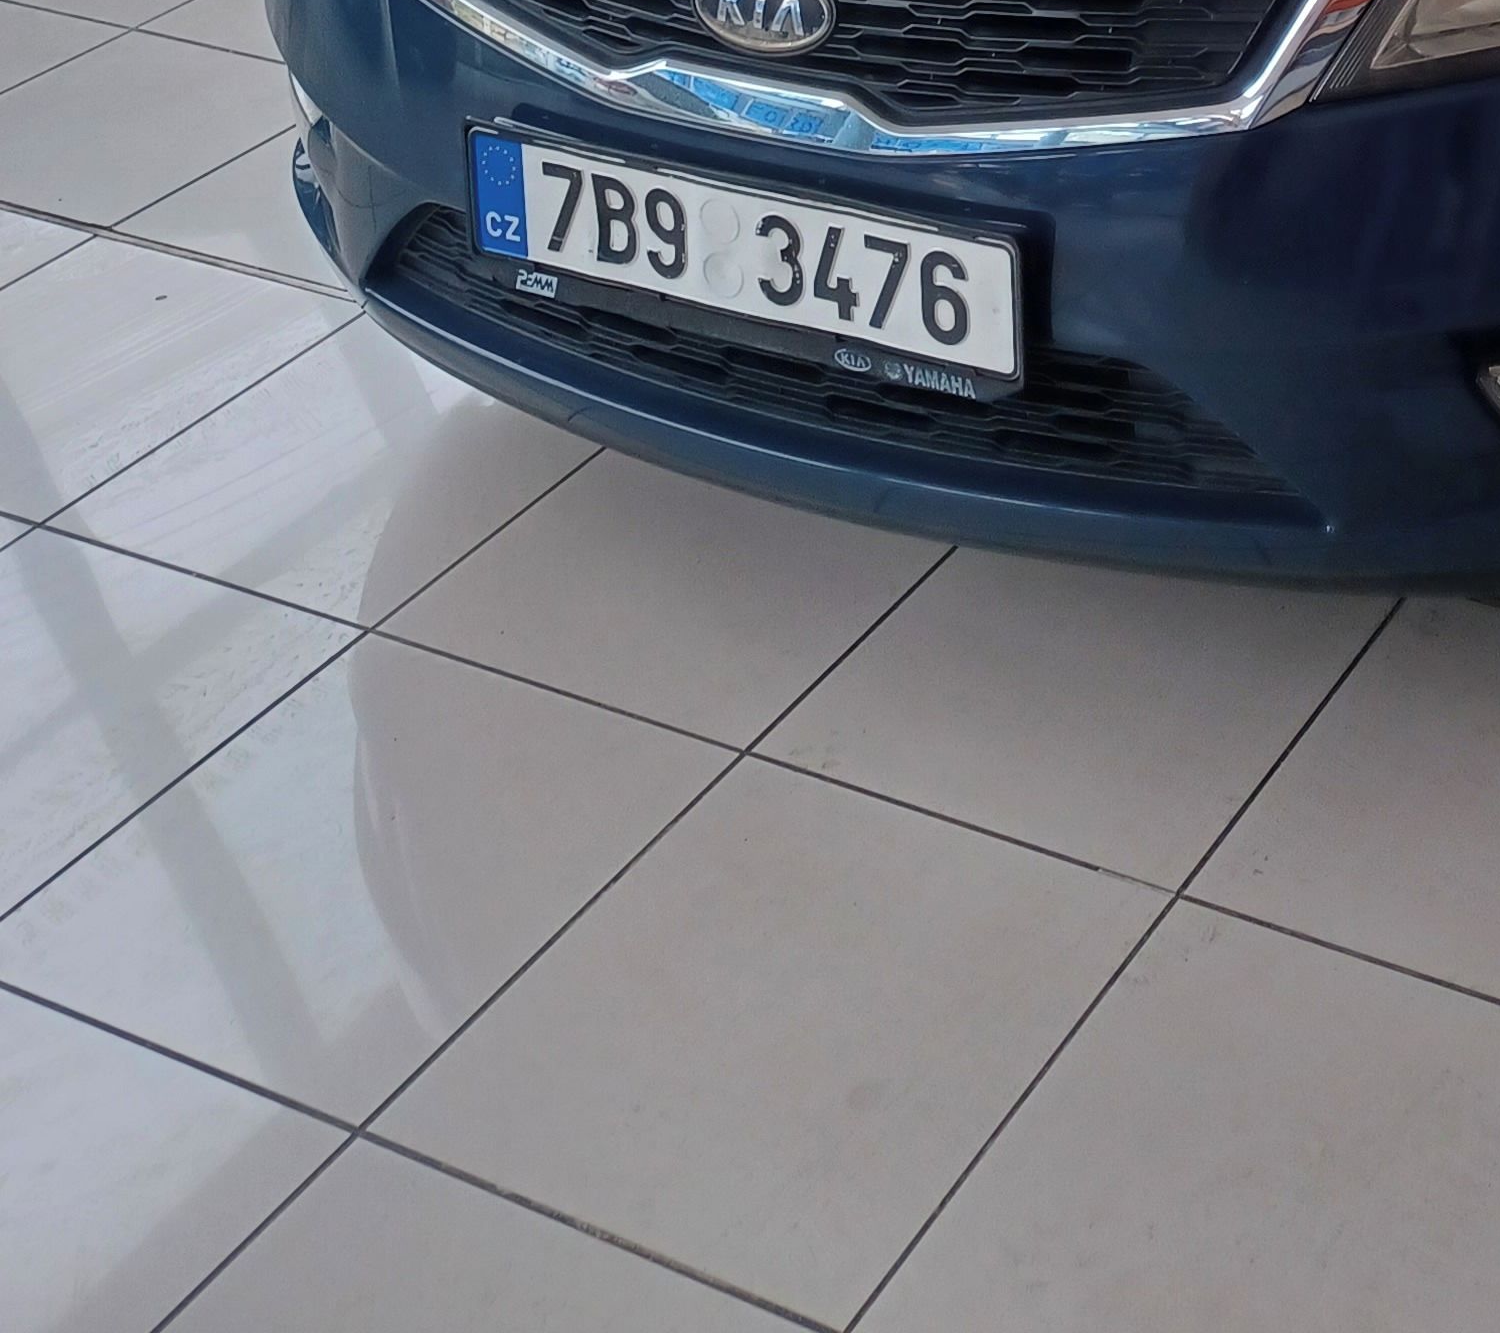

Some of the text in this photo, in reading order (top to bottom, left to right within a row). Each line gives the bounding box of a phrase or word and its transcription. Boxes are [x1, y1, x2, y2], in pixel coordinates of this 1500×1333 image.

[485, 210, 522, 243] CZ
[541, 161, 971, 346] 7B9 3476
[838, 350, 868, 370] KIA
[902, 363, 977, 400] YAMAHA
